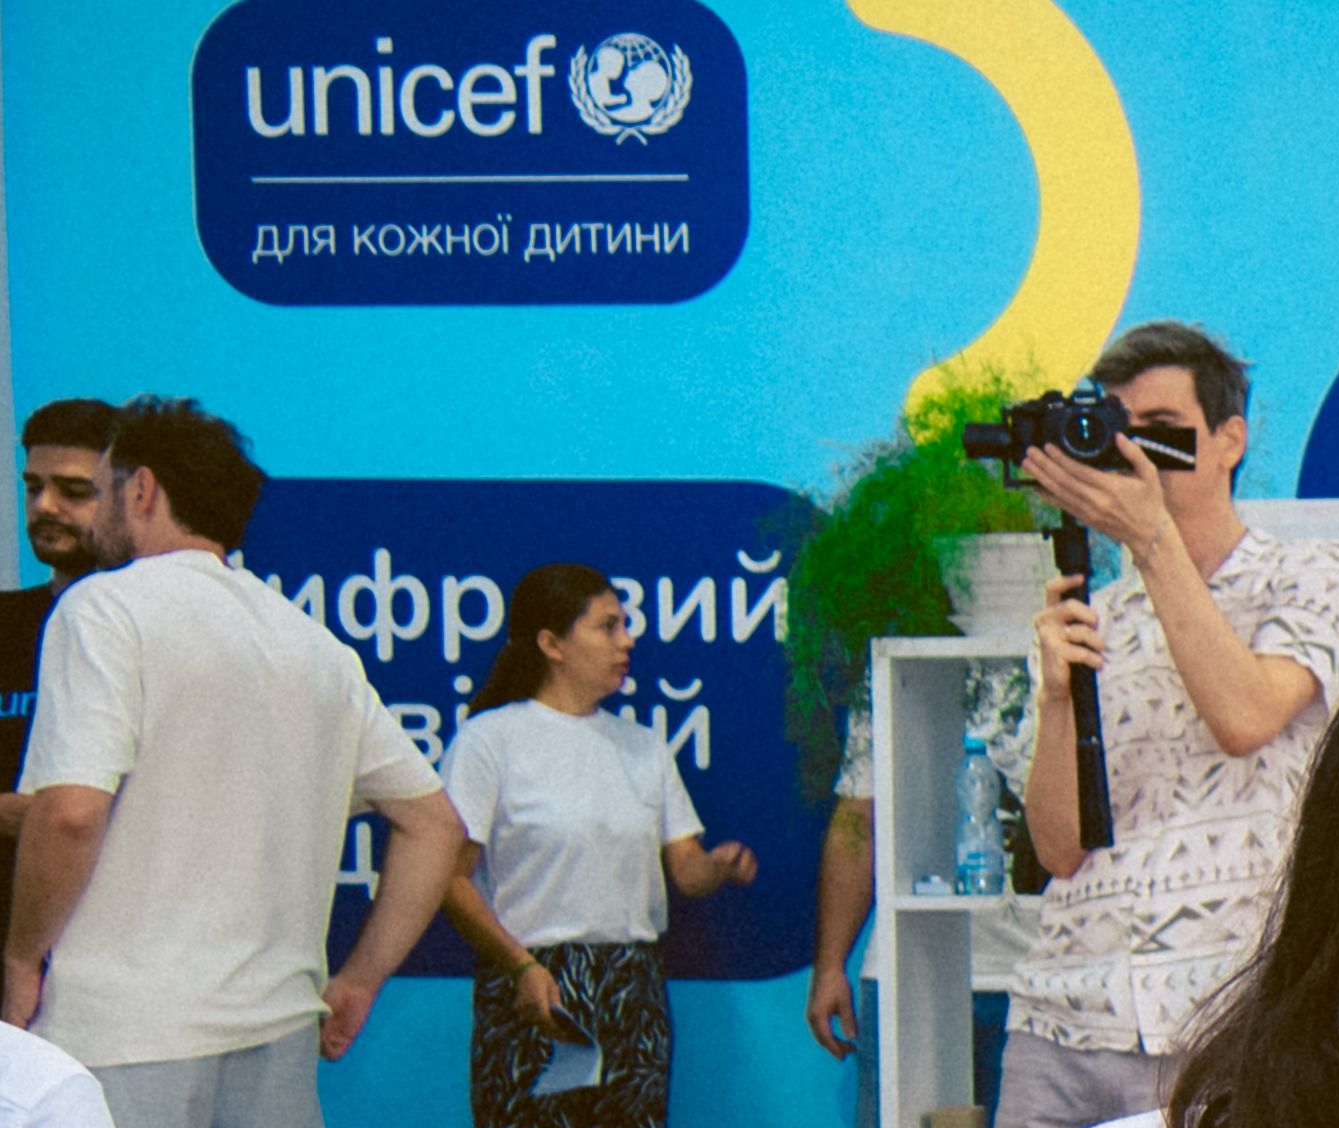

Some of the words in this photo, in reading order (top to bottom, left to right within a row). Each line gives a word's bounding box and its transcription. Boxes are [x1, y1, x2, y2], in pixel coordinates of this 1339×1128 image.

[246, 34, 557, 138] unicef
[252, 224, 337, 264] для
[353, 214, 513, 256] кожної
[523, 222, 690, 263] дитини
[228, 547, 789, 663] ифрвий
